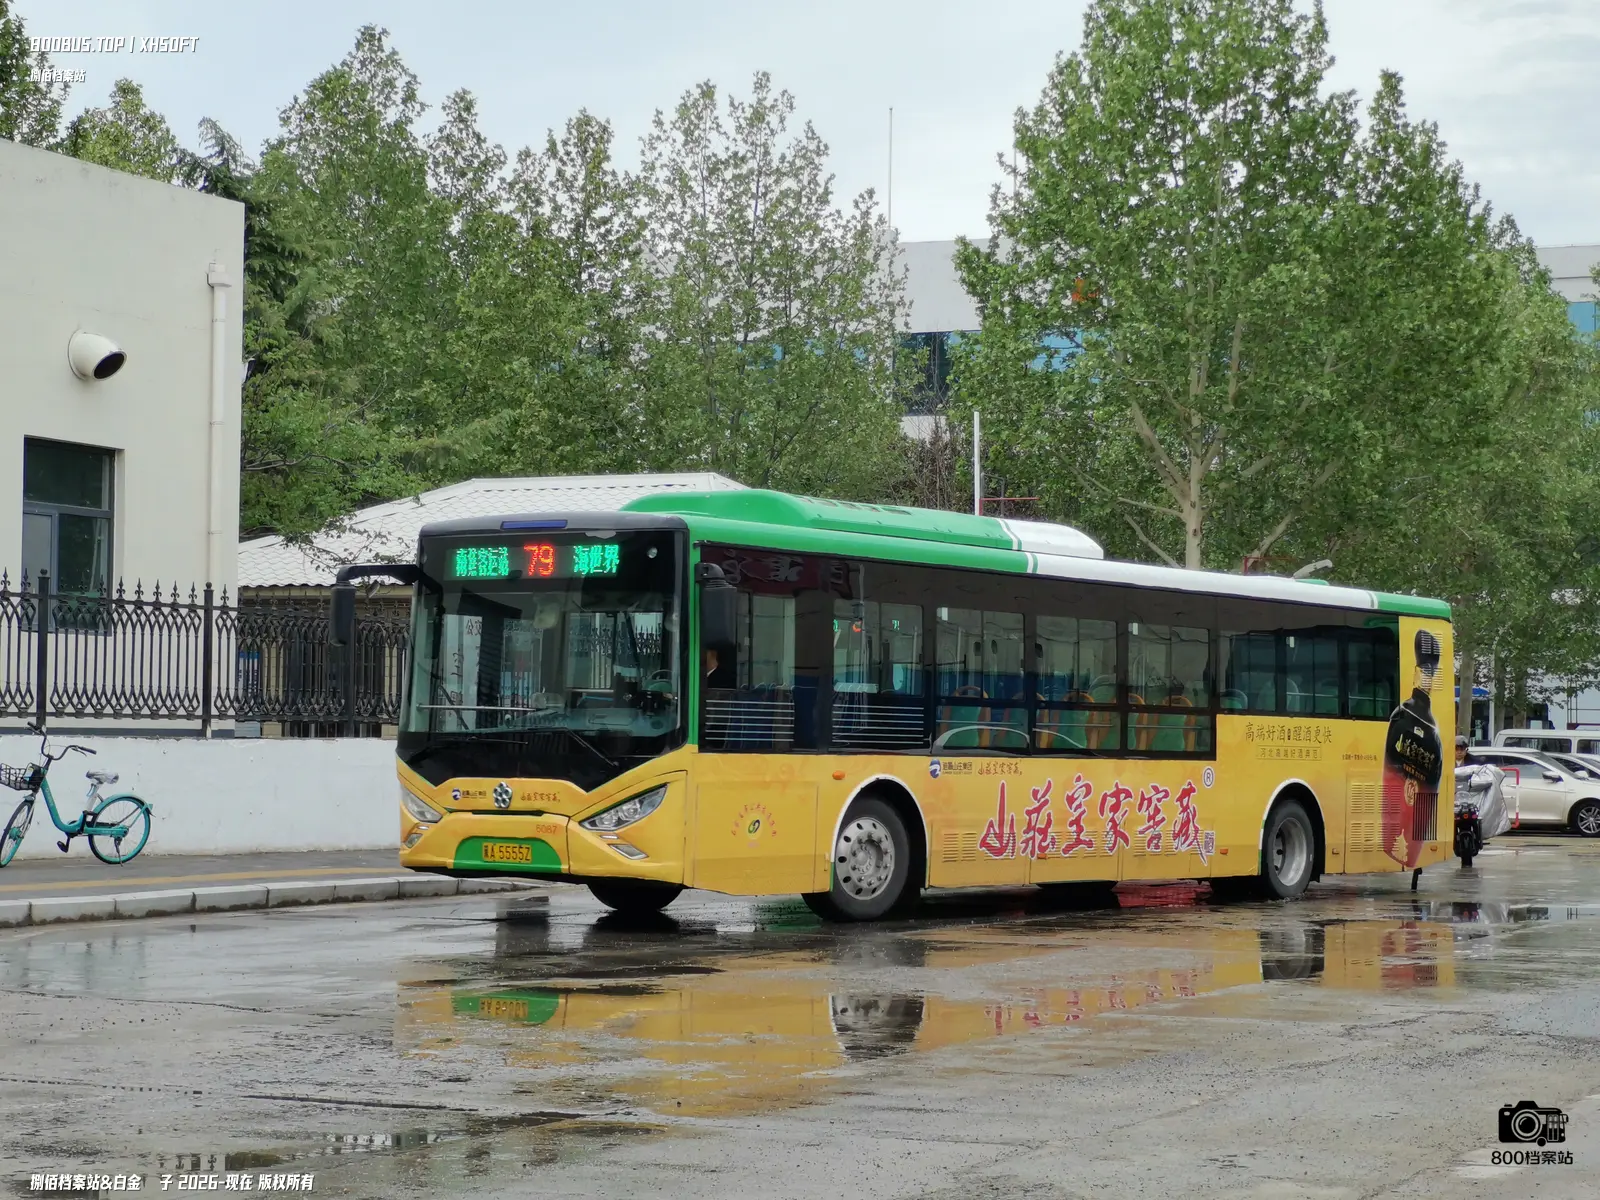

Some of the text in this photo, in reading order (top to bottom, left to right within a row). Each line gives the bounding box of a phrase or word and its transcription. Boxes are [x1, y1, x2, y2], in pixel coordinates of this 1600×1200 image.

[524, 543, 555, 577] 79
[572, 544, 620, 576] 海世界
